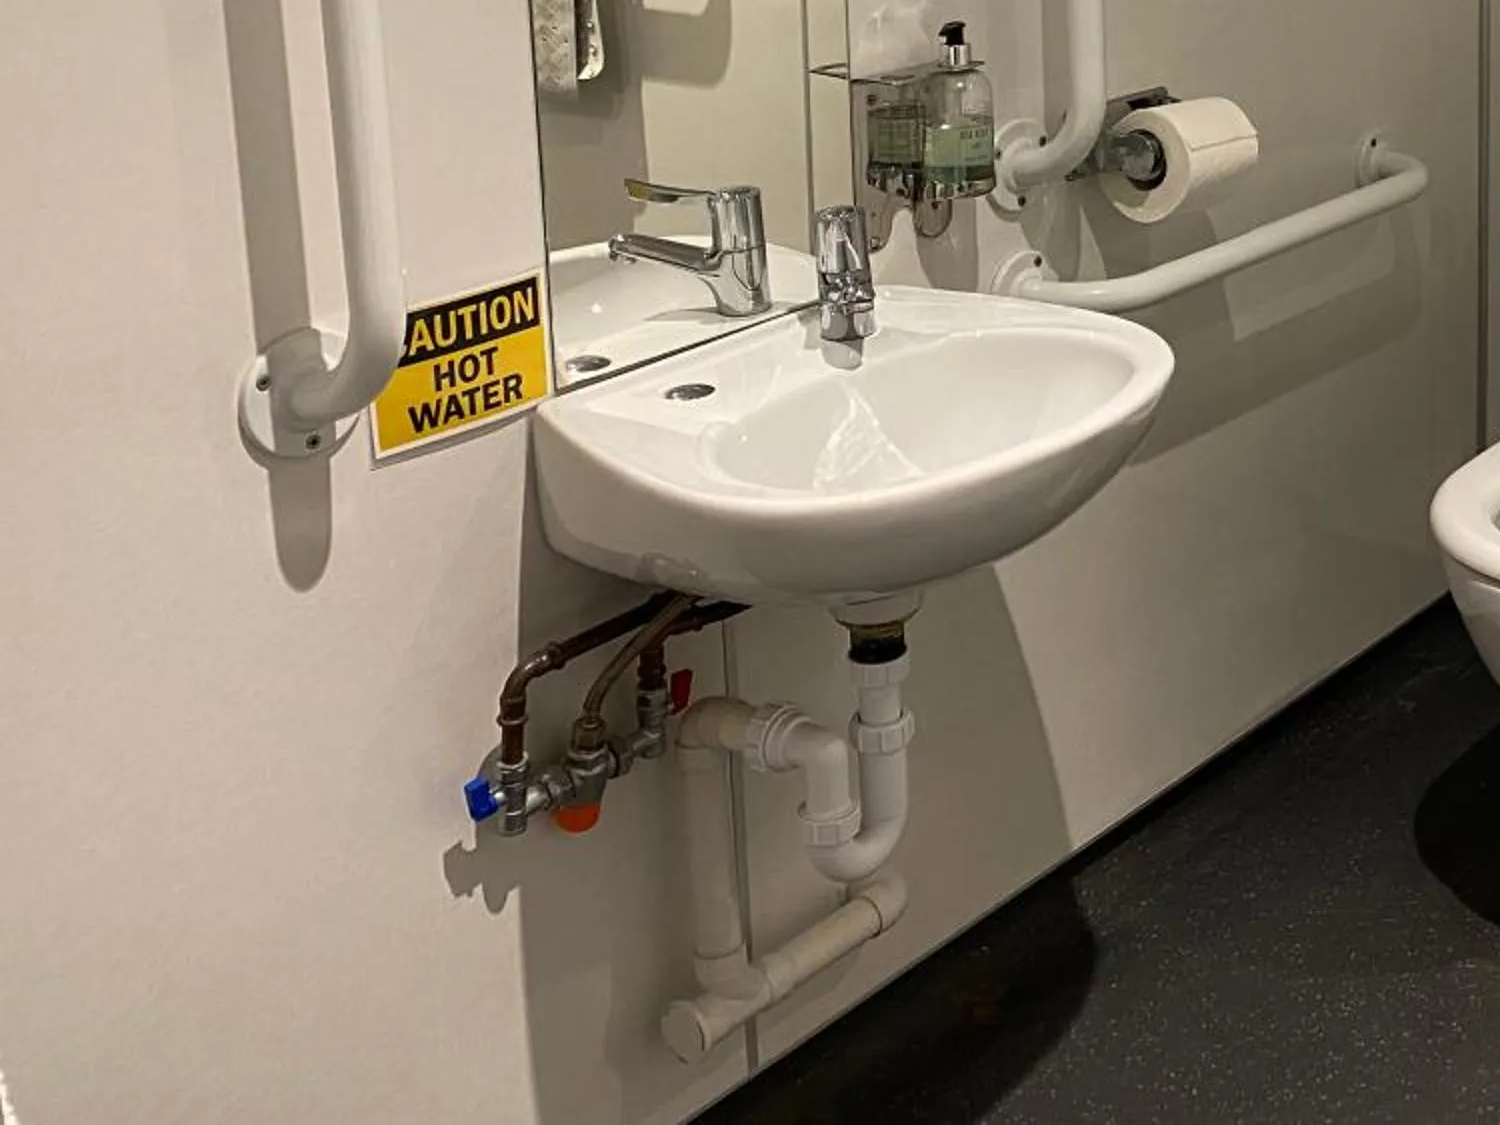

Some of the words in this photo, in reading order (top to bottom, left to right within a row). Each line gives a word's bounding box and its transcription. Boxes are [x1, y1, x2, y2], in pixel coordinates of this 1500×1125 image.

[403, 287, 533, 357] AUTION
[432, 346, 498, 392] HOT
[407, 373, 523, 434] WATER
